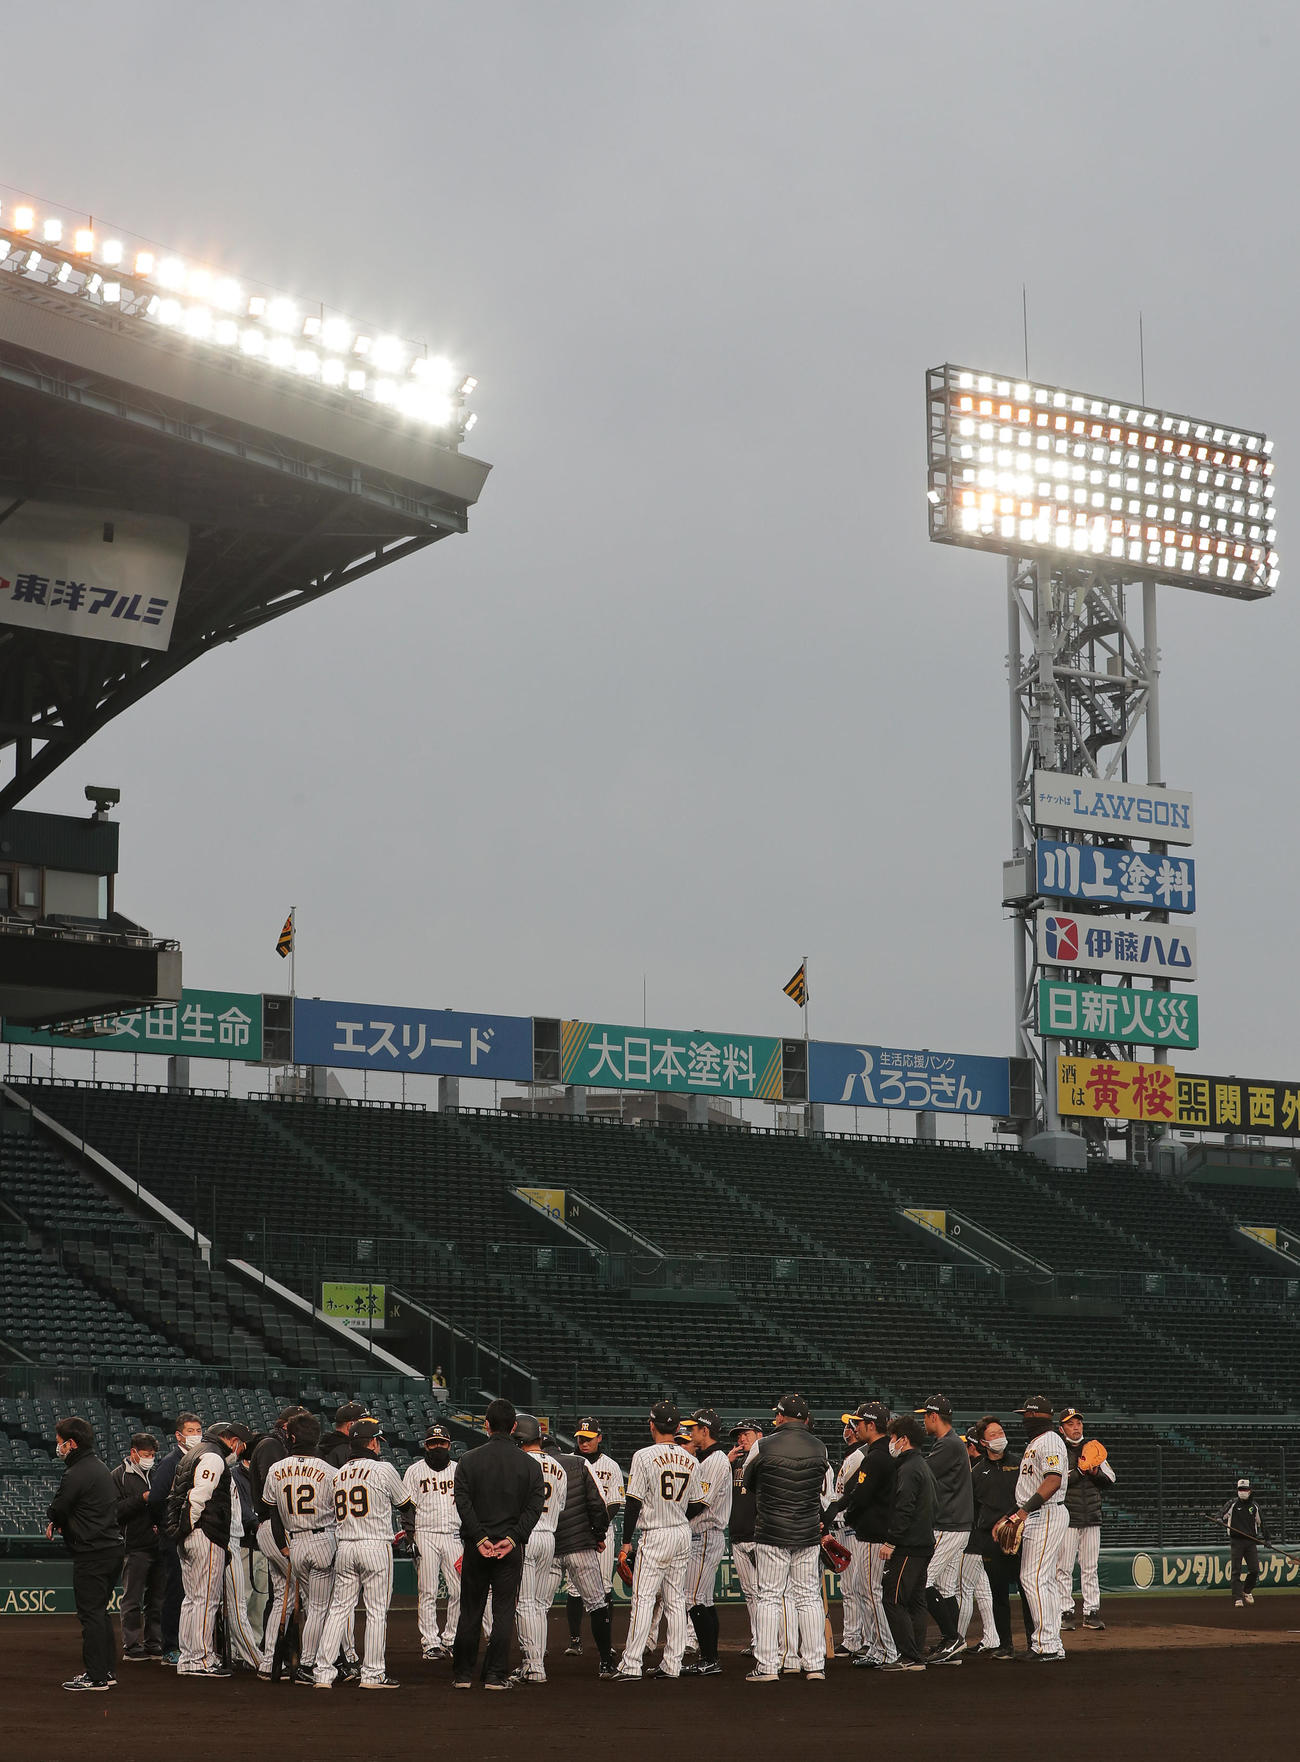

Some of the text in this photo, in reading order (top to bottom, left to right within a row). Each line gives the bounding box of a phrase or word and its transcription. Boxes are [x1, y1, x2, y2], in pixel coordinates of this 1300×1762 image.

[11, 574, 169, 625] 東洋アルミ
[1039, 789, 1190, 829] チケットは LAWSON
[1044, 846, 1193, 908] 川上塗料
[1085, 928, 1192, 968] 伊藤ハム
[1049, 987, 1190, 1041] 日新火災
[333, 1020, 495, 1066] エスリード
[588, 1033, 756, 1091] 大日本塗料
[880, 1052, 955, 1071] 生活応援バンク
[880, 1069, 981, 1111] ろうきん
[1085, 1063, 1174, 1119] 黄桜
[202, 1469, 215, 1483] 81
[274, 1466, 326, 1483] SAKAMOTO
[653, 1453, 696, 1472] TAKATERA
[1022, 1463, 1034, 1476] 24
[283, 1484, 316, 1515] 12
[335, 1485, 370, 1522] 89
[661, 1470, 691, 1502] 67
[4, 1589, 57, 1612] ASSIC
